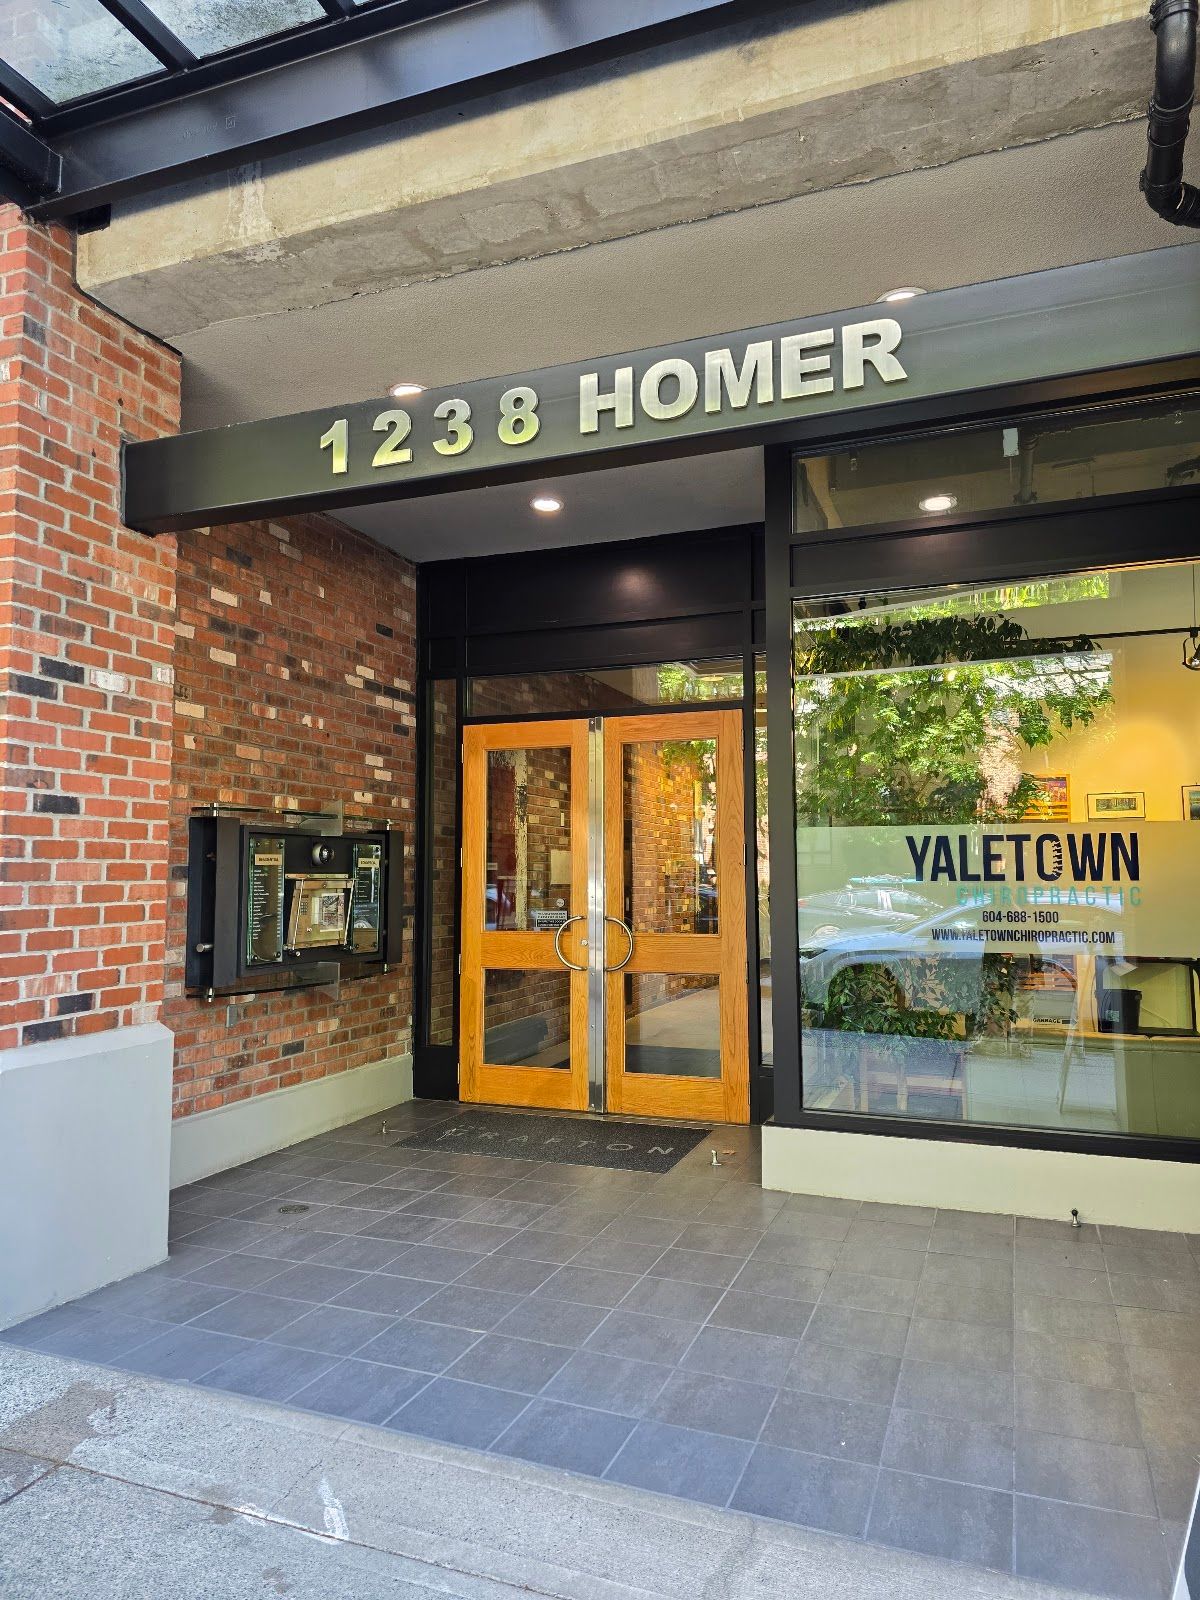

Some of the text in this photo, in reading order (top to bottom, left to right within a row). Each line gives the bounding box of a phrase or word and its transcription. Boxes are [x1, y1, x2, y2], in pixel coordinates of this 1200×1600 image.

[579, 318, 909, 436] HOMER
[905, 832, 1140, 881] YALETOWN
[956, 885, 1142, 907] CHIROPRACTIC
[982, 911, 1060, 924] 604-688-1500
[931, 928, 1115, 944] WWW.YALETOWNCHIROPRACTIC.COM
